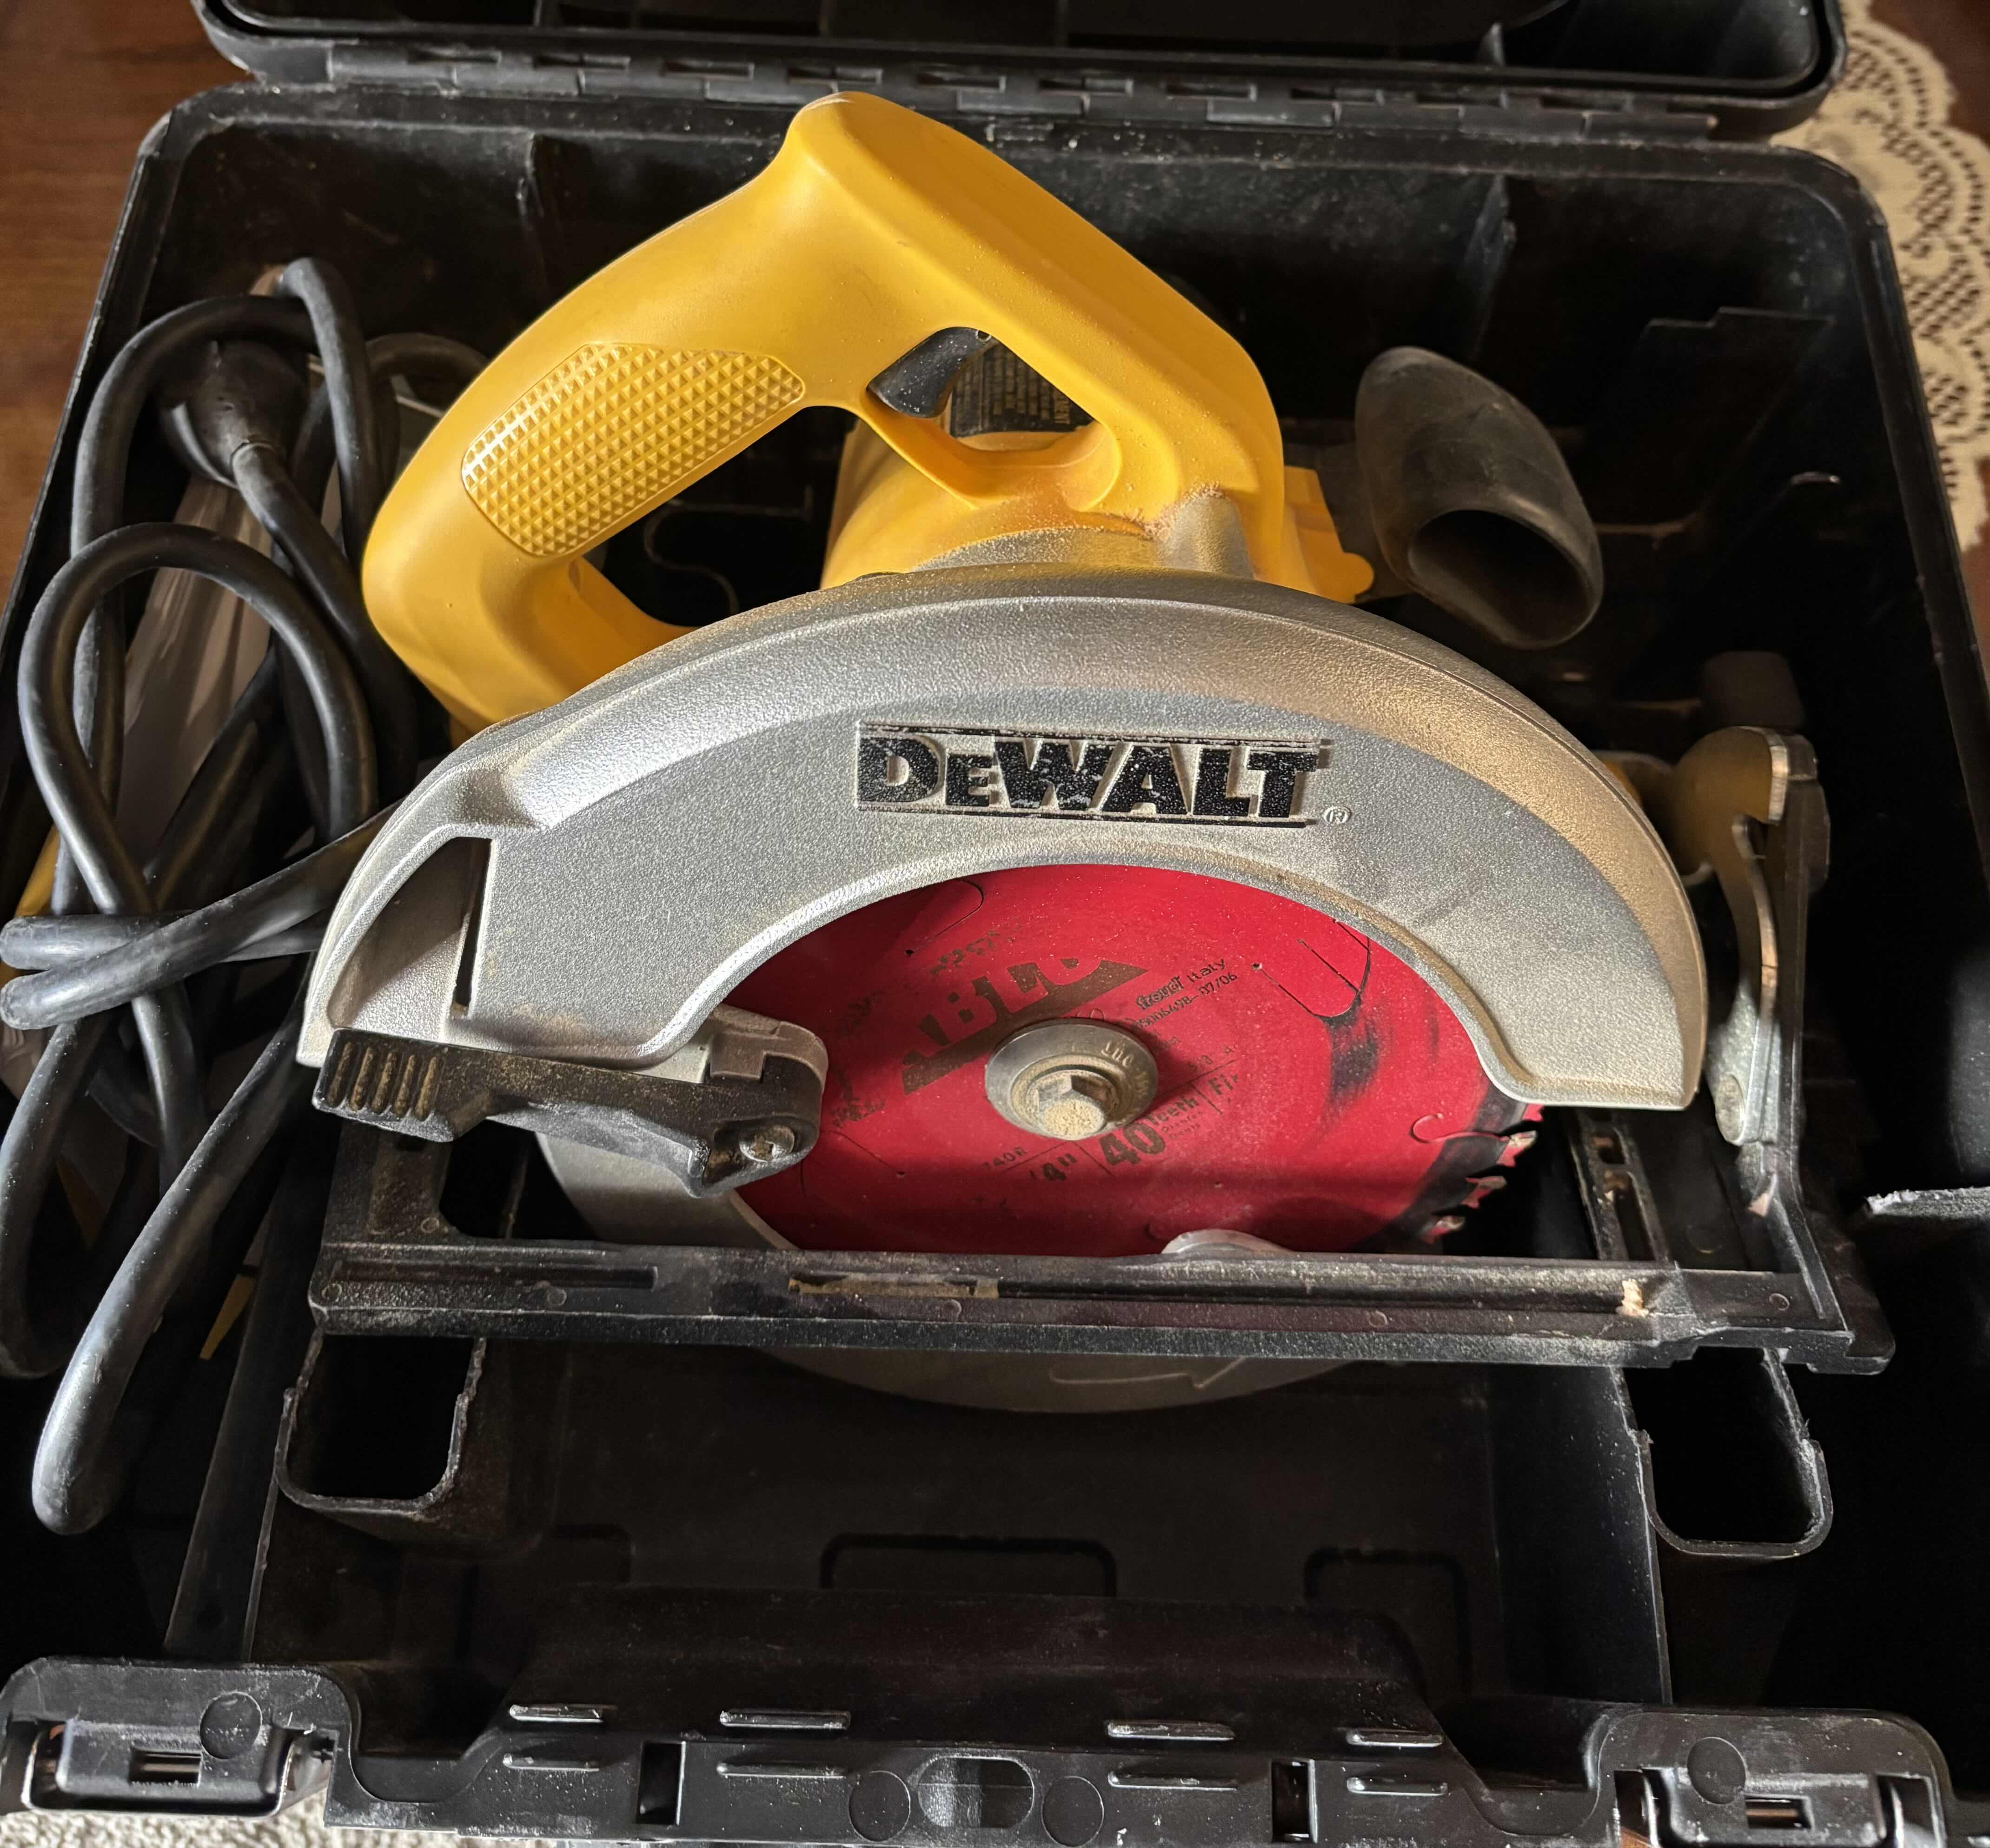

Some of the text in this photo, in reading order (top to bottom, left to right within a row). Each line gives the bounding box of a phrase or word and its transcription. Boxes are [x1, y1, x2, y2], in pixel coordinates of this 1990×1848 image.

[856, 735, 1317, 819] DEWALT
[1187, 958, 1226, 983] Italy
[1098, 1123, 1166, 1165] 40
